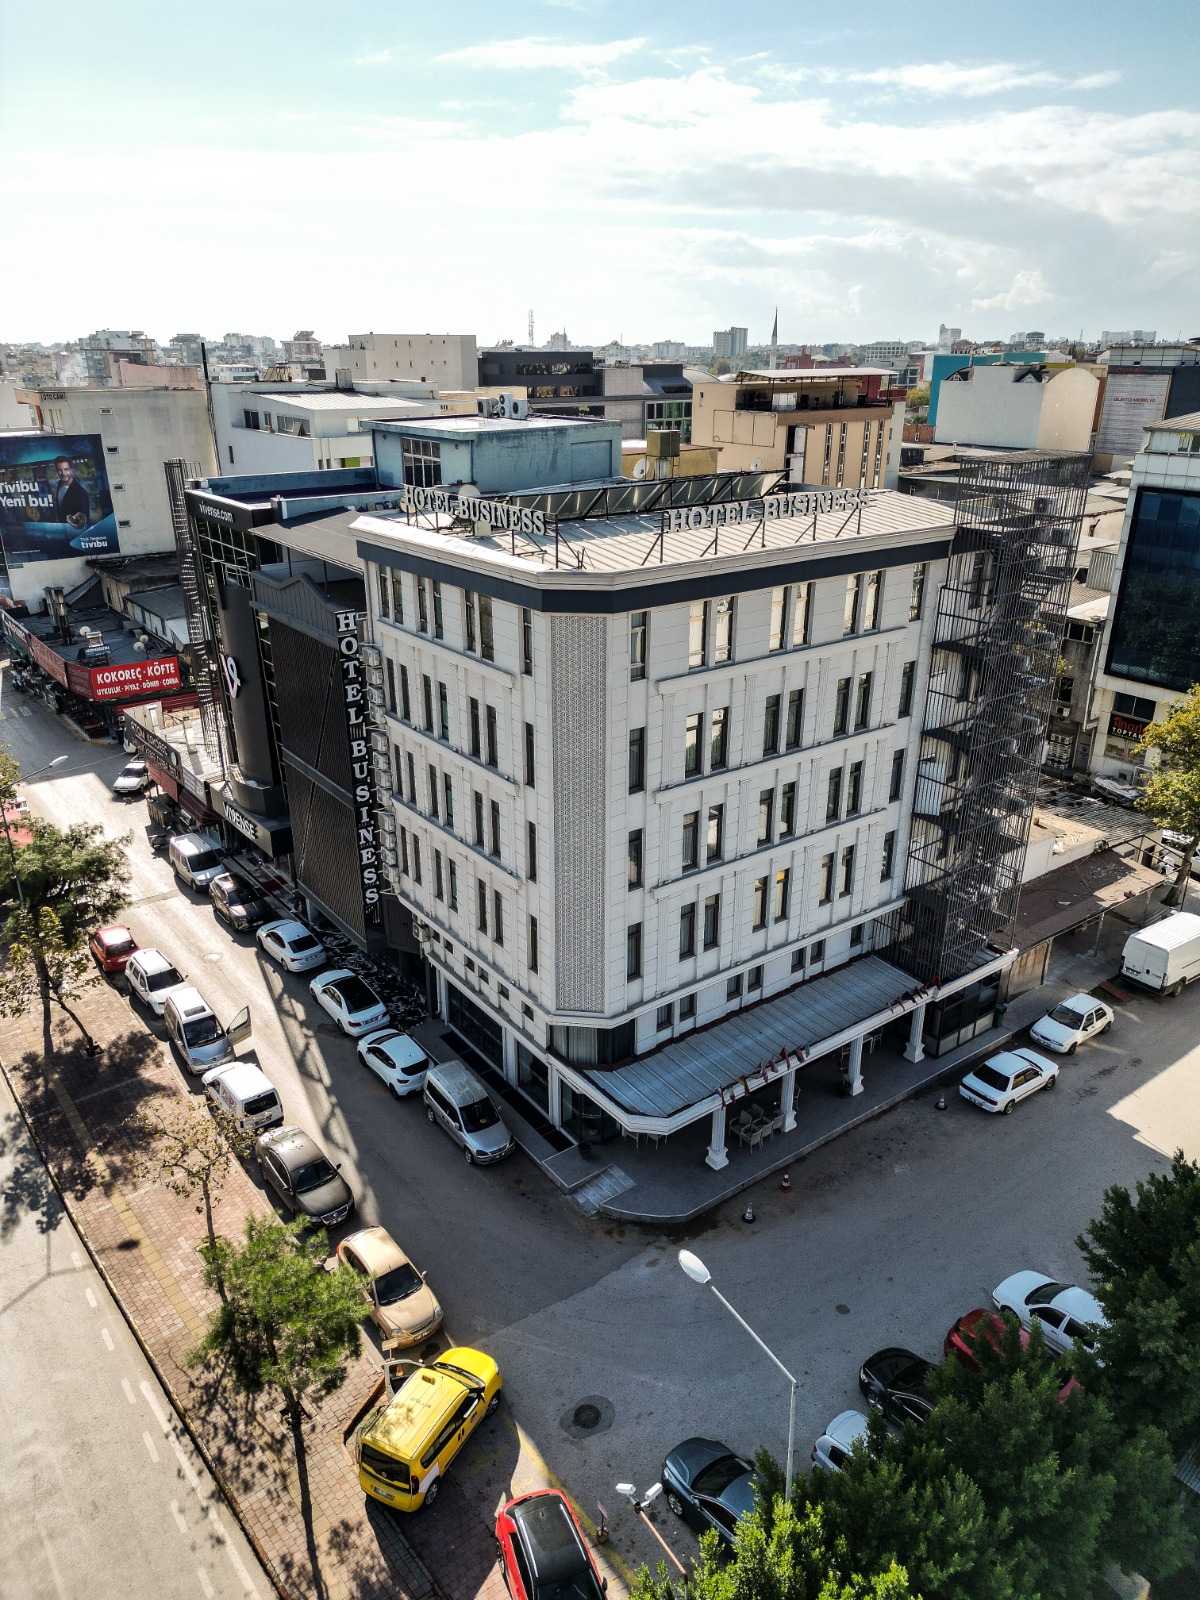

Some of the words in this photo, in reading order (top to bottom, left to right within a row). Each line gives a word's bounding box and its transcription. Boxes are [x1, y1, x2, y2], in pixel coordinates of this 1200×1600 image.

[0, 480, 39, 493] Tivibu
[0, 495, 26, 507] Yeni
[28, 494, 54, 507] bu!
[199, 501, 234, 523] vivense.com
[404, 485, 454, 515] HOTEL
[458, 496, 547, 536] BUSINESS
[668, 501, 756, 533] HOTEL
[763, 489, 870, 521] BUSINESS
[96, 667, 142, 685] KOKOREÇ
[147, 661, 175, 677] KÖFTE
[96, 685, 122, 696] UYKULUK
[124, 682, 140, 692] PİYAZ
[142, 679, 160, 689] DÖNER
[162, 677, 180, 688] ÇORBA
[336, 612, 364, 725] HOTEL
[351, 739, 379, 904] BUSINESS
[222, 801, 256, 840] VIVENSE
